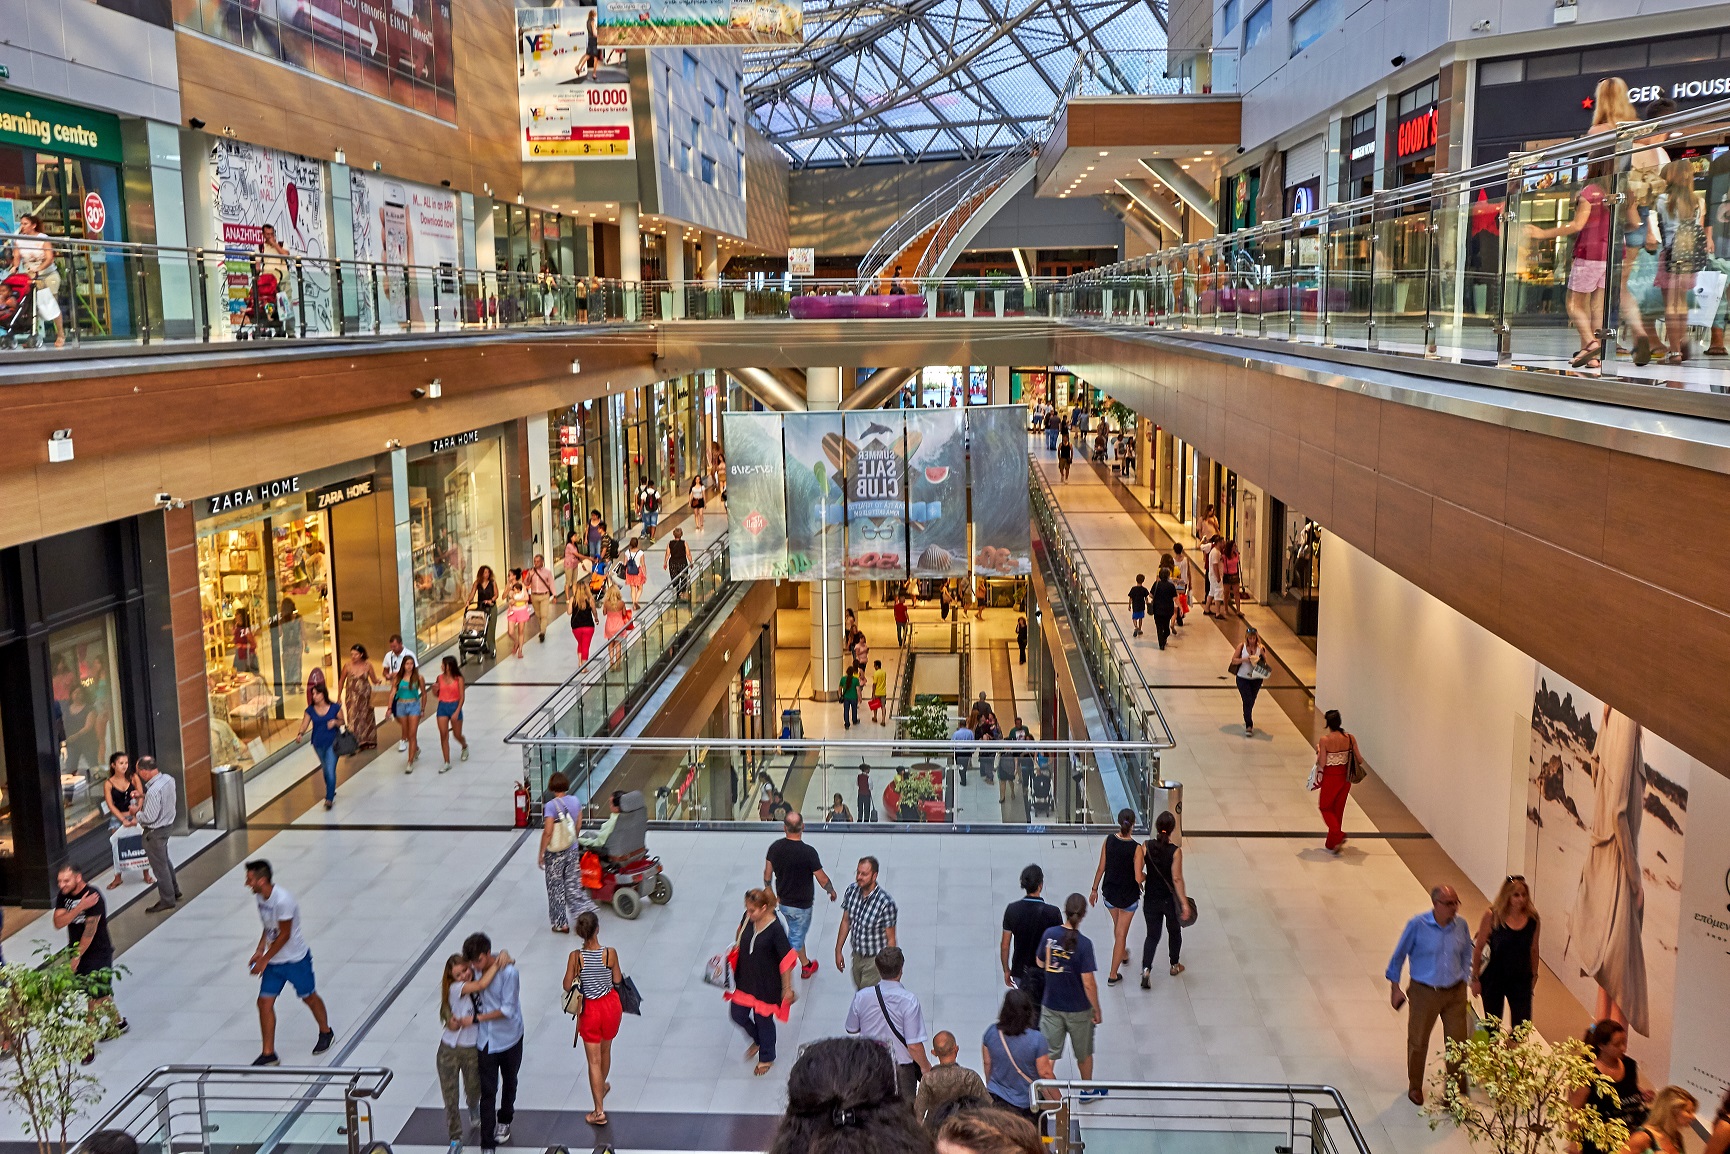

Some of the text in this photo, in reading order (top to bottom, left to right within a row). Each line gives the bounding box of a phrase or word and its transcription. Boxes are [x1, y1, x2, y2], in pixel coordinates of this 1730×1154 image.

[525, 33, 553, 53] YES
[586, 89, 627, 105] 10.000
[1627, 78, 1730, 102] GER HOUSE
[53, 124, 98, 147] centre
[434, 430, 479, 453] ZARA HOME
[212, 476, 300, 514] ZARA HOME
[318, 480, 371, 508] ZARA HOME
